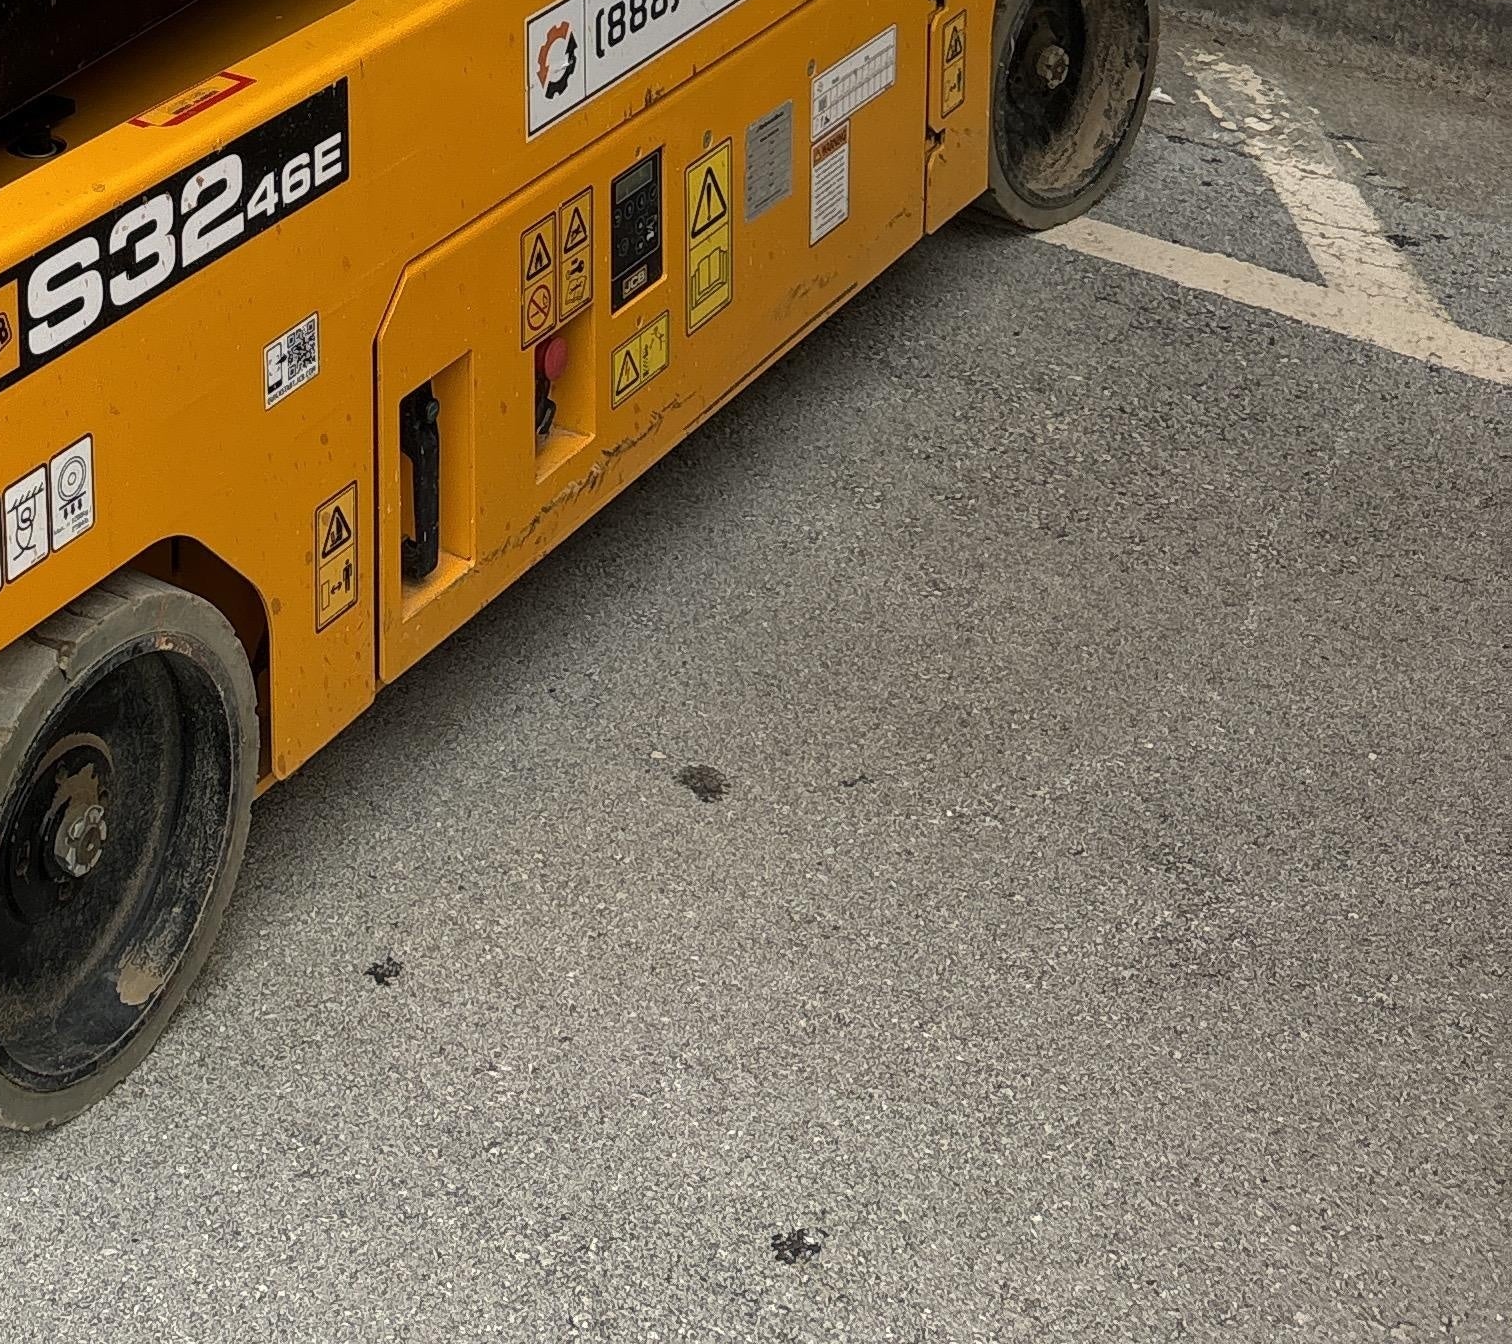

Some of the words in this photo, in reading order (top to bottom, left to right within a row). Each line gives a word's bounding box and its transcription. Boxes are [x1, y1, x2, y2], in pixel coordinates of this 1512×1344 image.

[27, 153, 245, 355] S32
[247, 132, 343, 219] 46E
[624, 269, 646, 295] JCB
